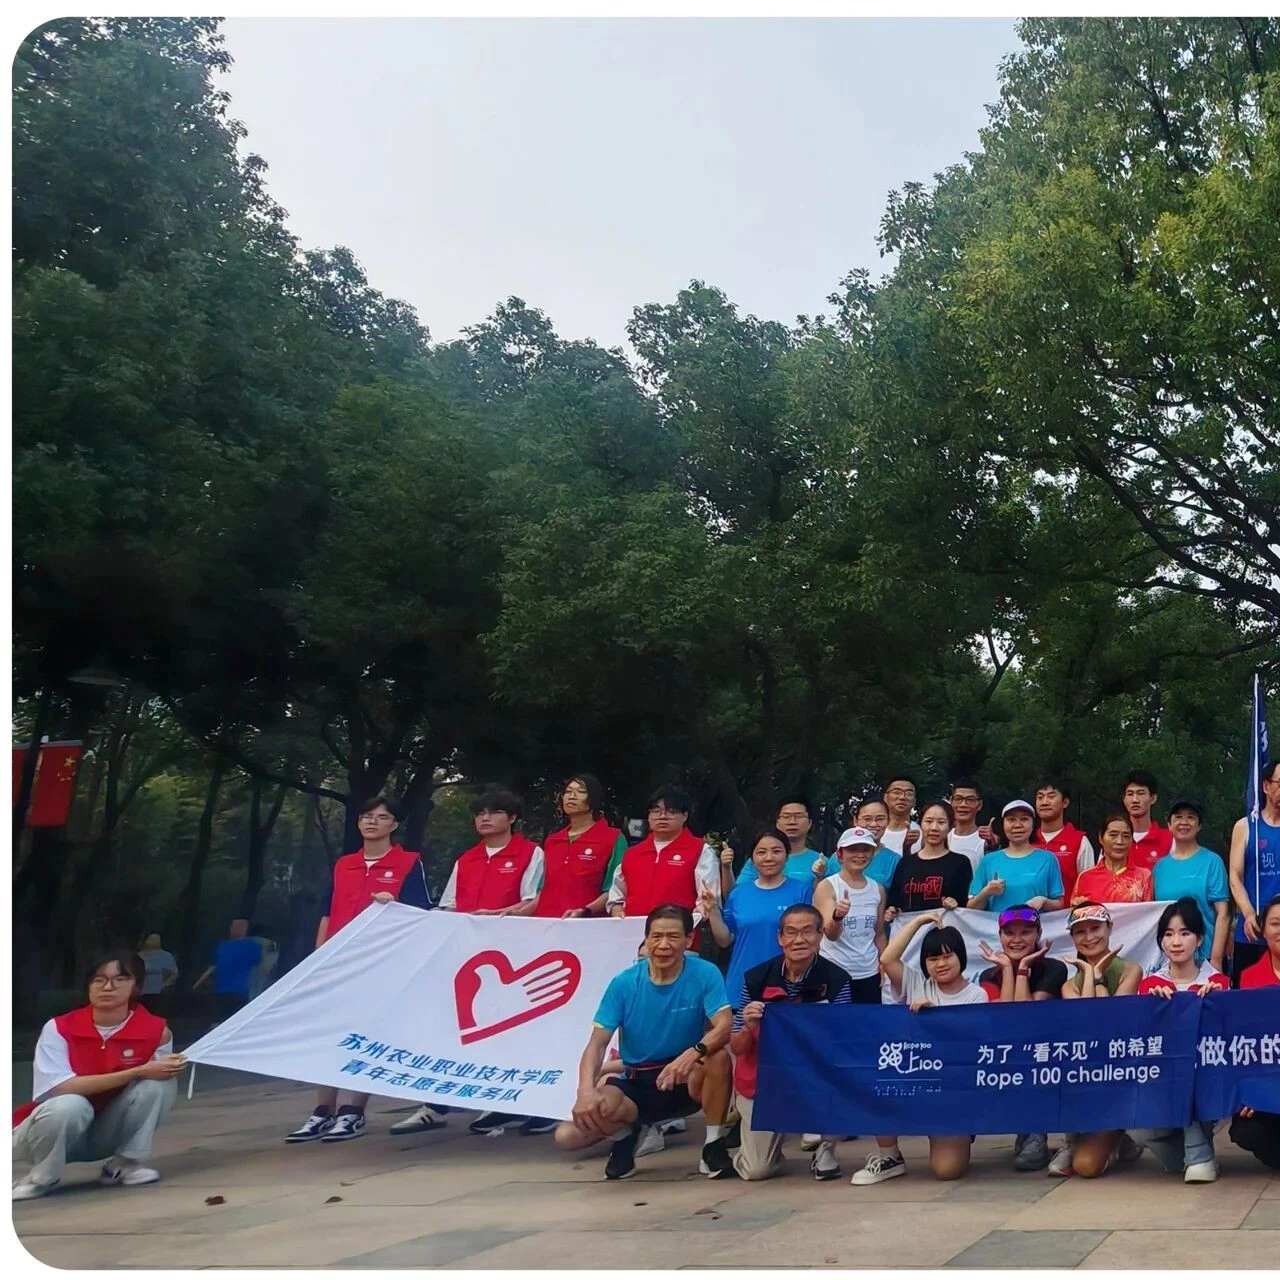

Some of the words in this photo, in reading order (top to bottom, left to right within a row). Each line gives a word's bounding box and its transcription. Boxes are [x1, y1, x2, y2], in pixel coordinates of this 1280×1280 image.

[337, 1033, 563, 1086] 苏州农业职业技术学院
[340, 1058, 524, 1102] 青年志愿者服务队
[976, 1070, 1024, 1089] Rope
[1031, 1067, 1062, 1085] 100
[1067, 1062, 1162, 1083] challenge
